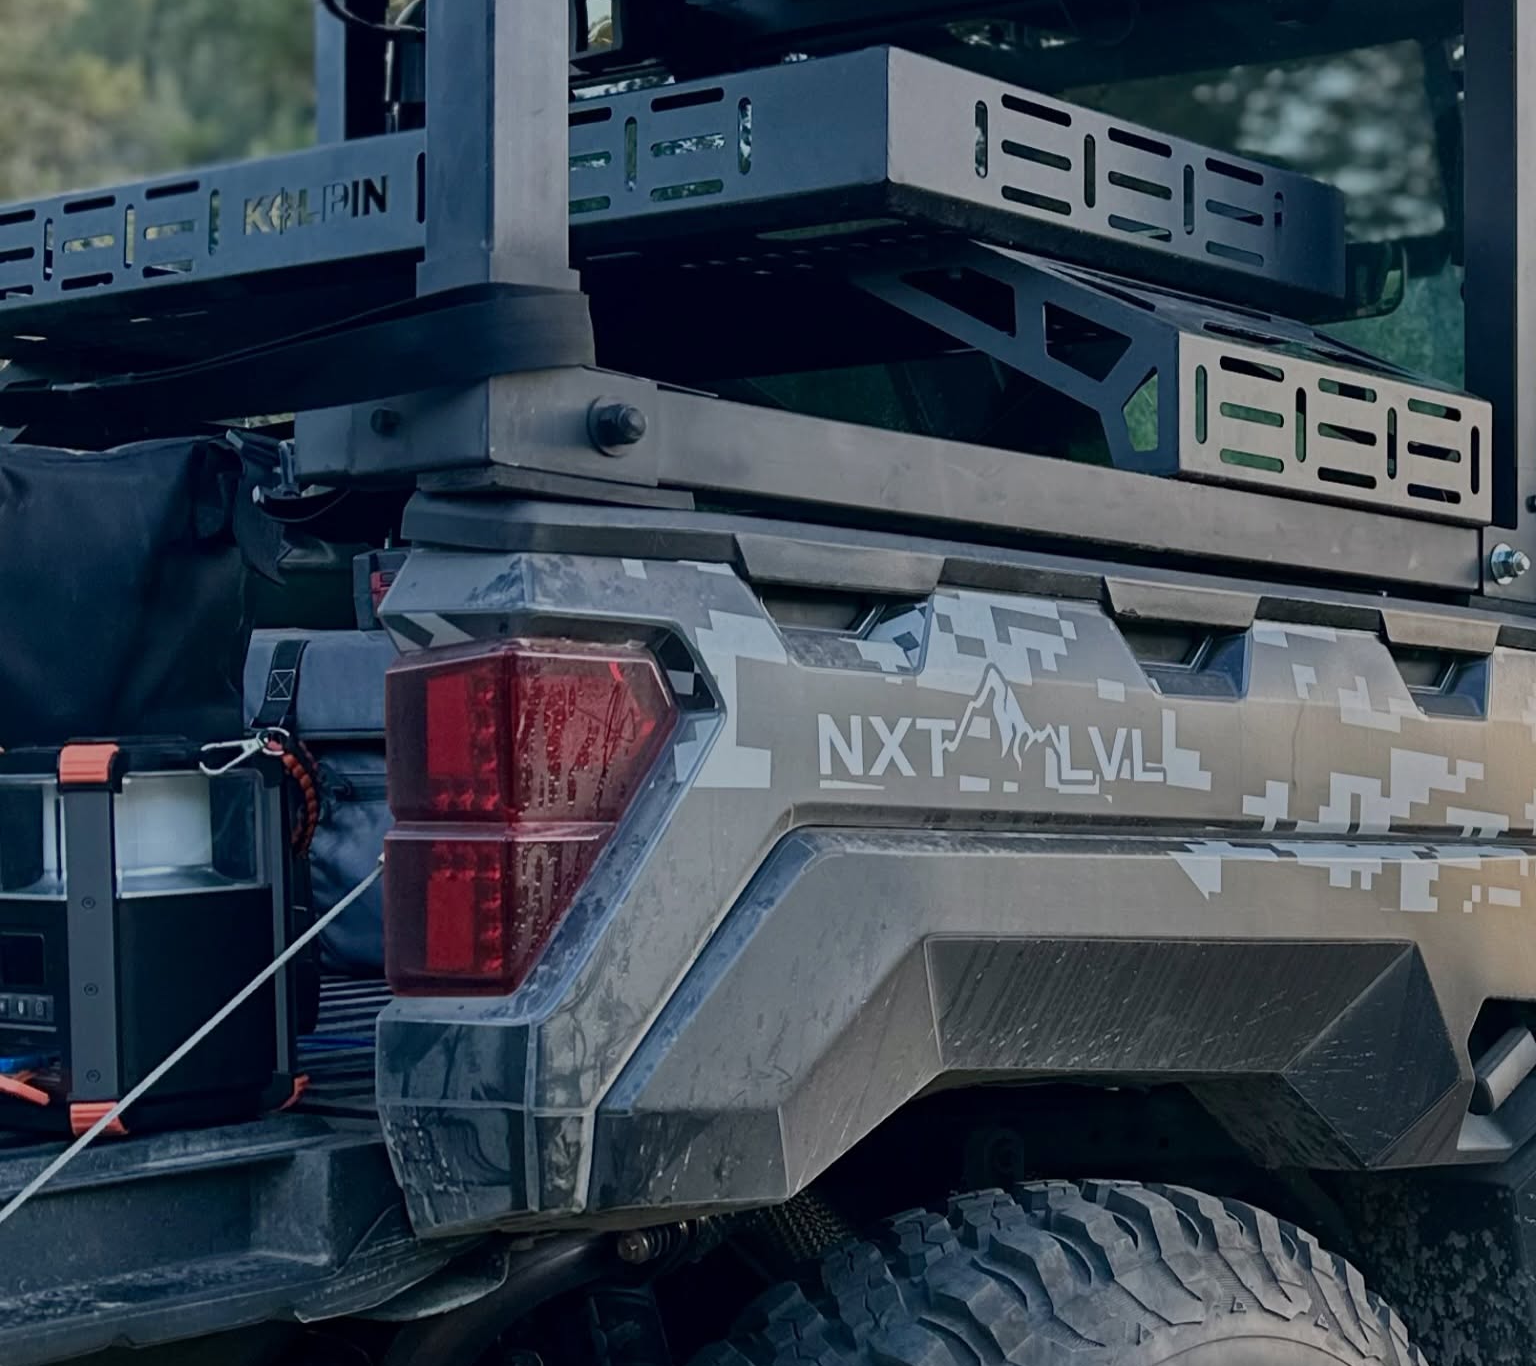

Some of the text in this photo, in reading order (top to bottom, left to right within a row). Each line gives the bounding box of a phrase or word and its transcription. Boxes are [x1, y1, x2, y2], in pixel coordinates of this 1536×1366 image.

[243, 174, 388, 236] KOLPIN
[817, 712, 1168, 783] NXT LVL
